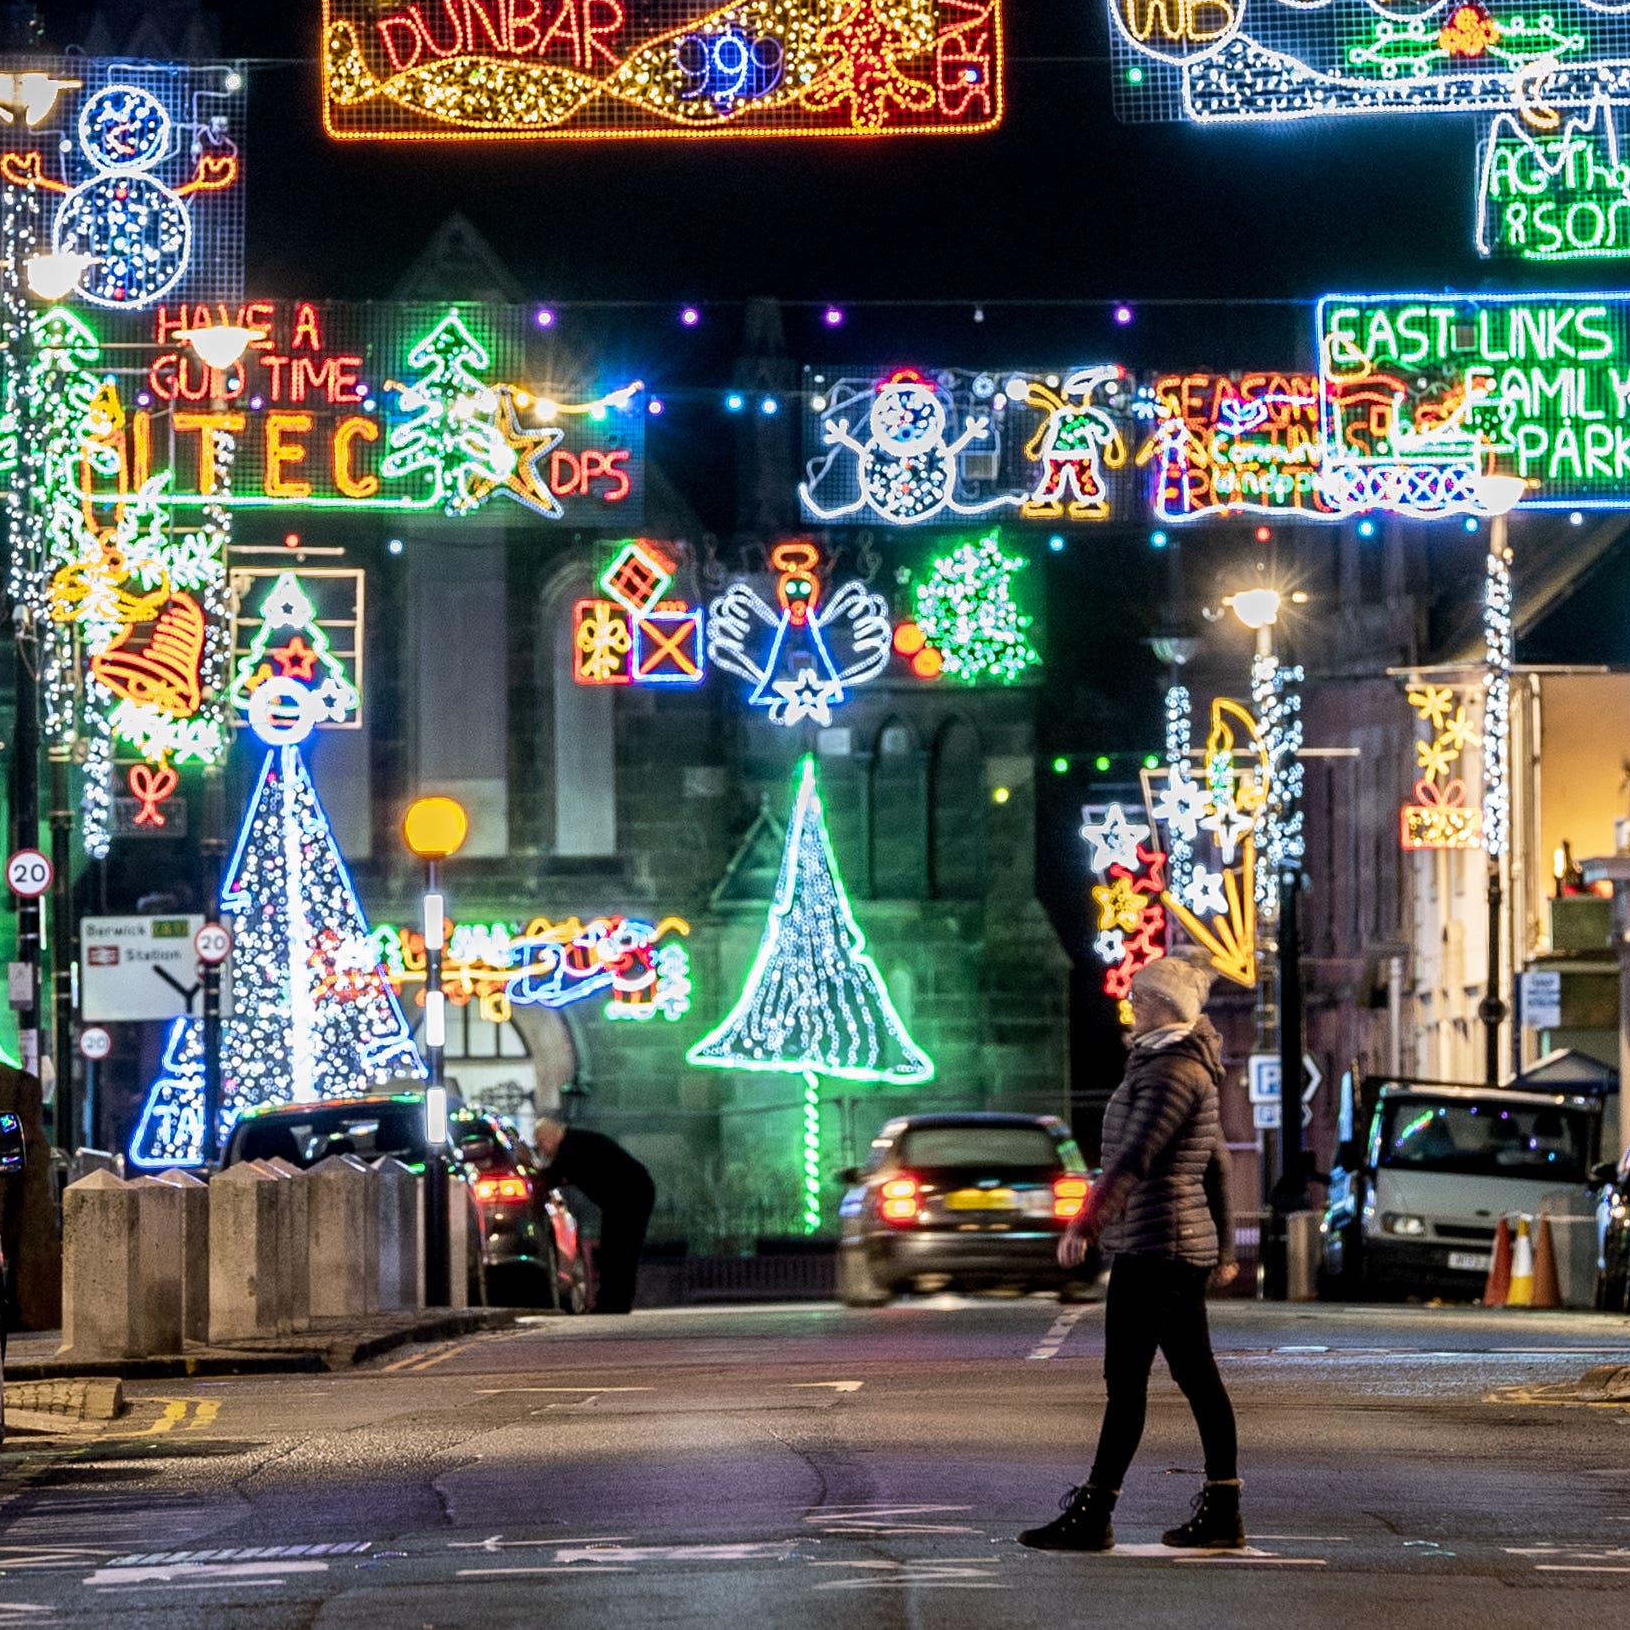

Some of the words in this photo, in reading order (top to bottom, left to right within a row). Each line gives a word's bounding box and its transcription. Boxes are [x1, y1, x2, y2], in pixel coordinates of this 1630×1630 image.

[156, 301, 275, 351] HAVE
[291, 301, 321, 352] A
[1330, 306, 1456, 364] EAST
[1478, 306, 1615, 362] LINKS
[259, 356, 365, 404] TIME
[550, 449, 631, 502] DPS
[13, 863, 47, 884] 20
[86, 924, 147, 937] Berwick
[200, 935, 226, 950] 20
[126, 948, 183, 961] Station
[85, 1036, 109, 1050] 20
